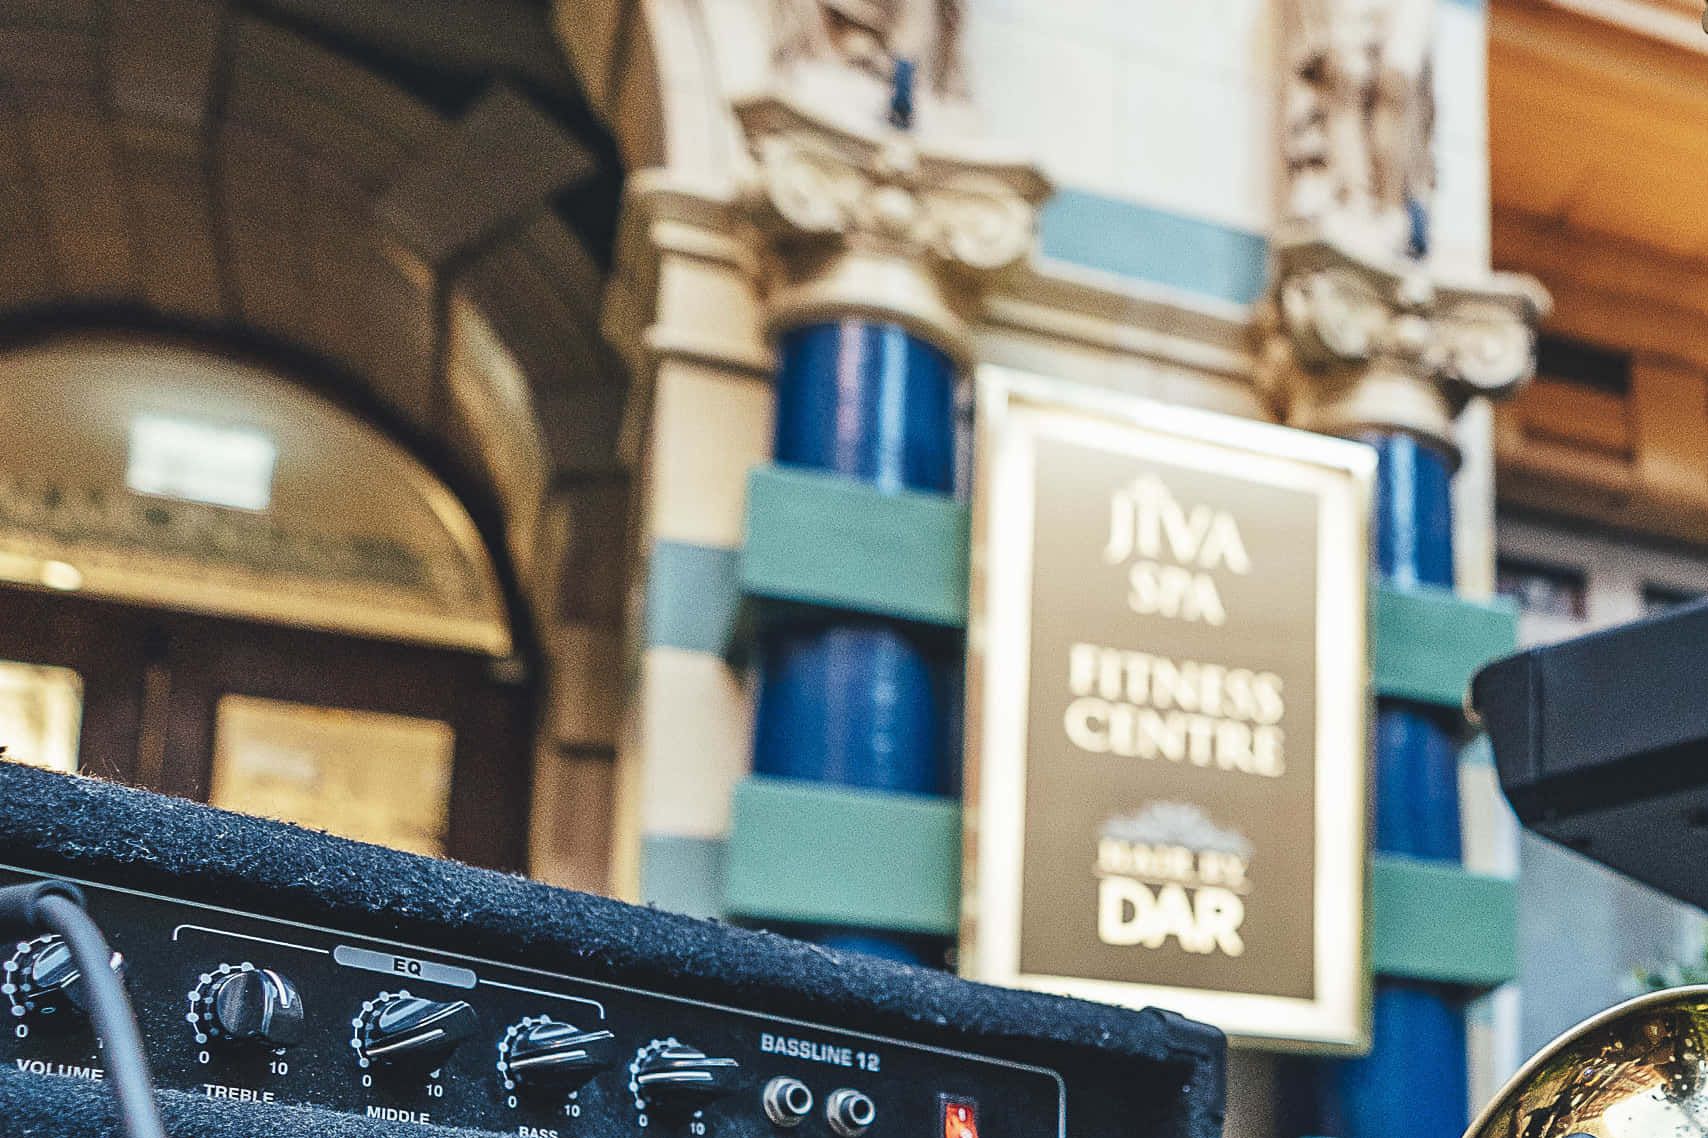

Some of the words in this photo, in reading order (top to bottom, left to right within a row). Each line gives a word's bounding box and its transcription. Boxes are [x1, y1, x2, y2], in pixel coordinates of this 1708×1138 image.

[1104, 474, 1251, 575] JIVA
[1128, 560, 1227, 626] SPA
[1070, 643, 1284, 725] FITNESS
[1064, 697, 1286, 778] CENTRE
[1098, 876, 1245, 957] DAR
[393, 957, 422, 976] EQ
[16, 1024, 29, 1038] 0
[199, 1051, 210, 1064] 0
[761, 1032, 853, 1067] BASSLINE
[856, 1051, 880, 1072] 12
[16, 1059, 104, 1082] VOLUME
[269, 1061, 288, 1075] 10
[362, 1074, 372, 1087] 0
[203, 1083, 275, 1104] TREBLE
[426, 1084, 443, 1097] 10
[508, 1095, 518, 1108] 0
[564, 1104, 580, 1117] 10
[366, 1105, 431, 1125] MIDDLE
[639, 1114, 648, 1127] 0
[690, 1122, 705, 1135] 10
